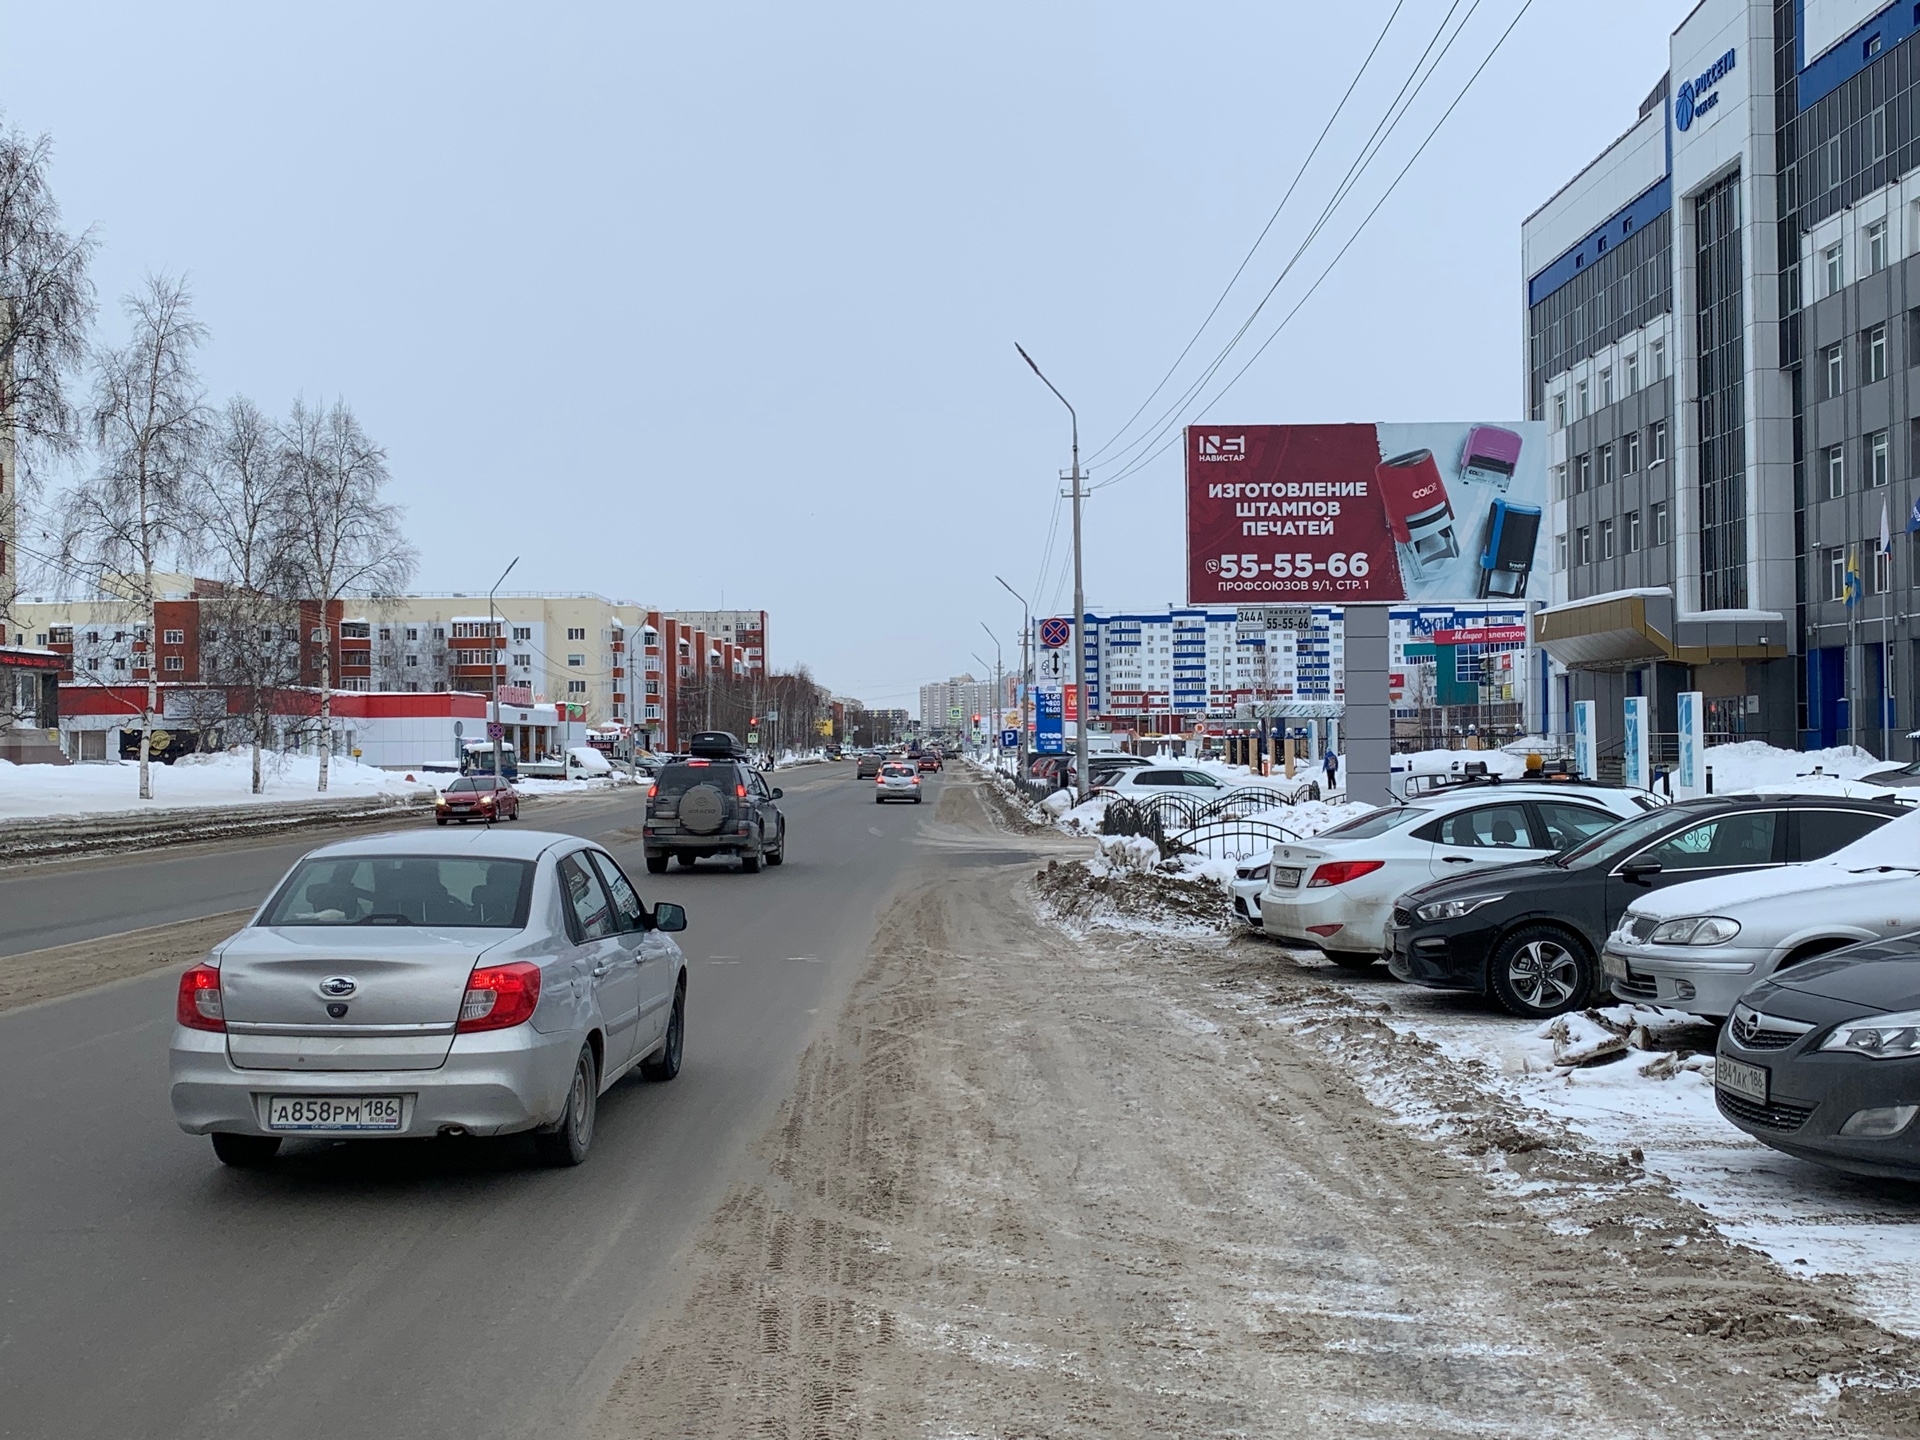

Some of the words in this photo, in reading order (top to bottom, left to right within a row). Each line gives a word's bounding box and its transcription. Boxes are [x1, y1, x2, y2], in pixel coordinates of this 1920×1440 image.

[1694, 48, 1735, 98] РОССЕТИ
[1198, 454, 1246, 462] НАВИСТАР
[1208, 482, 1368, 498] ИЗГОТОВЛЕНИЕ
[1235, 501, 1341, 517] ШТАМПОВ
[1242, 517, 1334, 536] ПЕЧАТЕЙ
[1218, 552, 1370, 579] 55-55-66
[1217, 580, 1309, 591] ПРОФСОЮЗОВ
[1312, 580, 1333, 591] 9/1,
[1336, 580, 1362, 590] СТР.
[1365, 580, 1369, 590] 1
[1266, 617, 1309, 629] 55-55-66
[277, 1101, 360, 1122] А858РМ
[364, 1100, 394, 1117] 186
